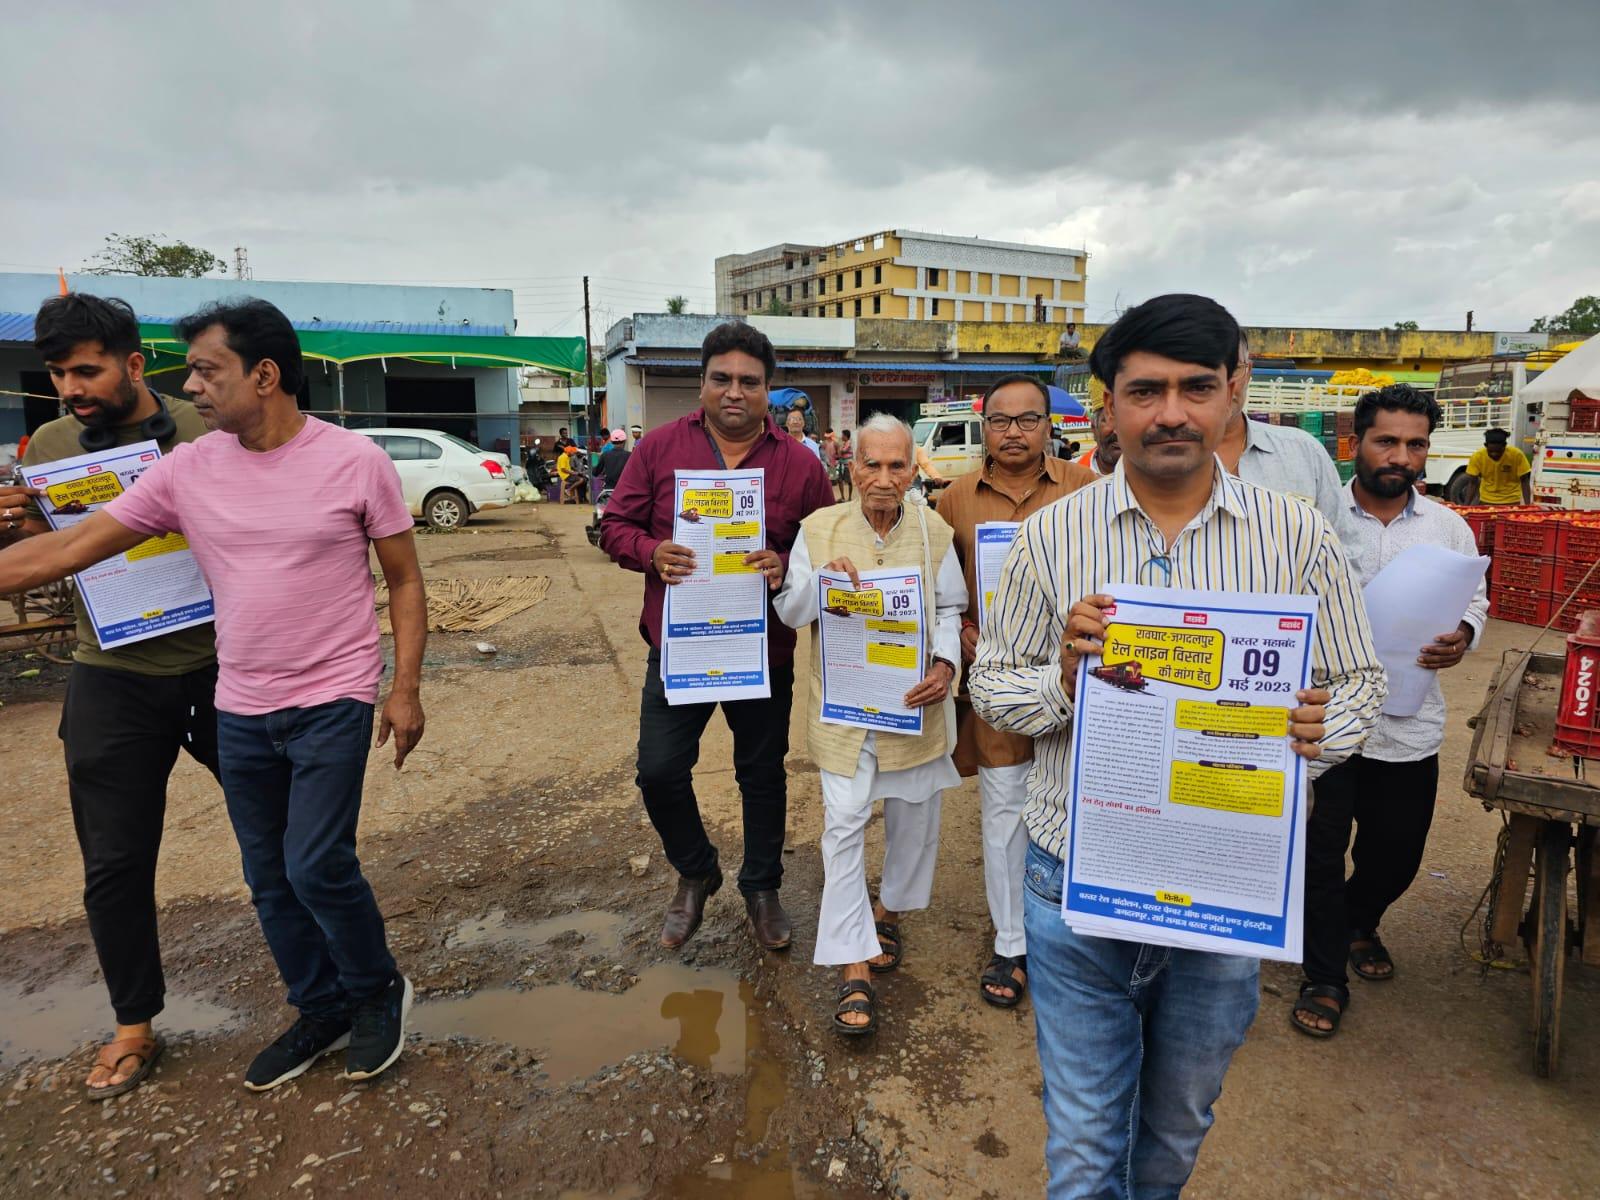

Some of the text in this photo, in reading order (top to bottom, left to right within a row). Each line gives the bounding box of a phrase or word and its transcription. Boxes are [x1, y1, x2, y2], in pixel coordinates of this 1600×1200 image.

[740, 495, 754, 509] 09
[892, 595, 910, 610] 09
[1231, 636, 1296, 649] बस्तर महाबंद
[1112, 638, 1213, 665] रेल लाइन विस्तार
[1243, 648, 1280, 677] 09
[1158, 665, 1211, 686] की मांग हेतु
[1228, 677, 1292, 693] मई 2023
[1098, 892, 1110, 904] रेल
